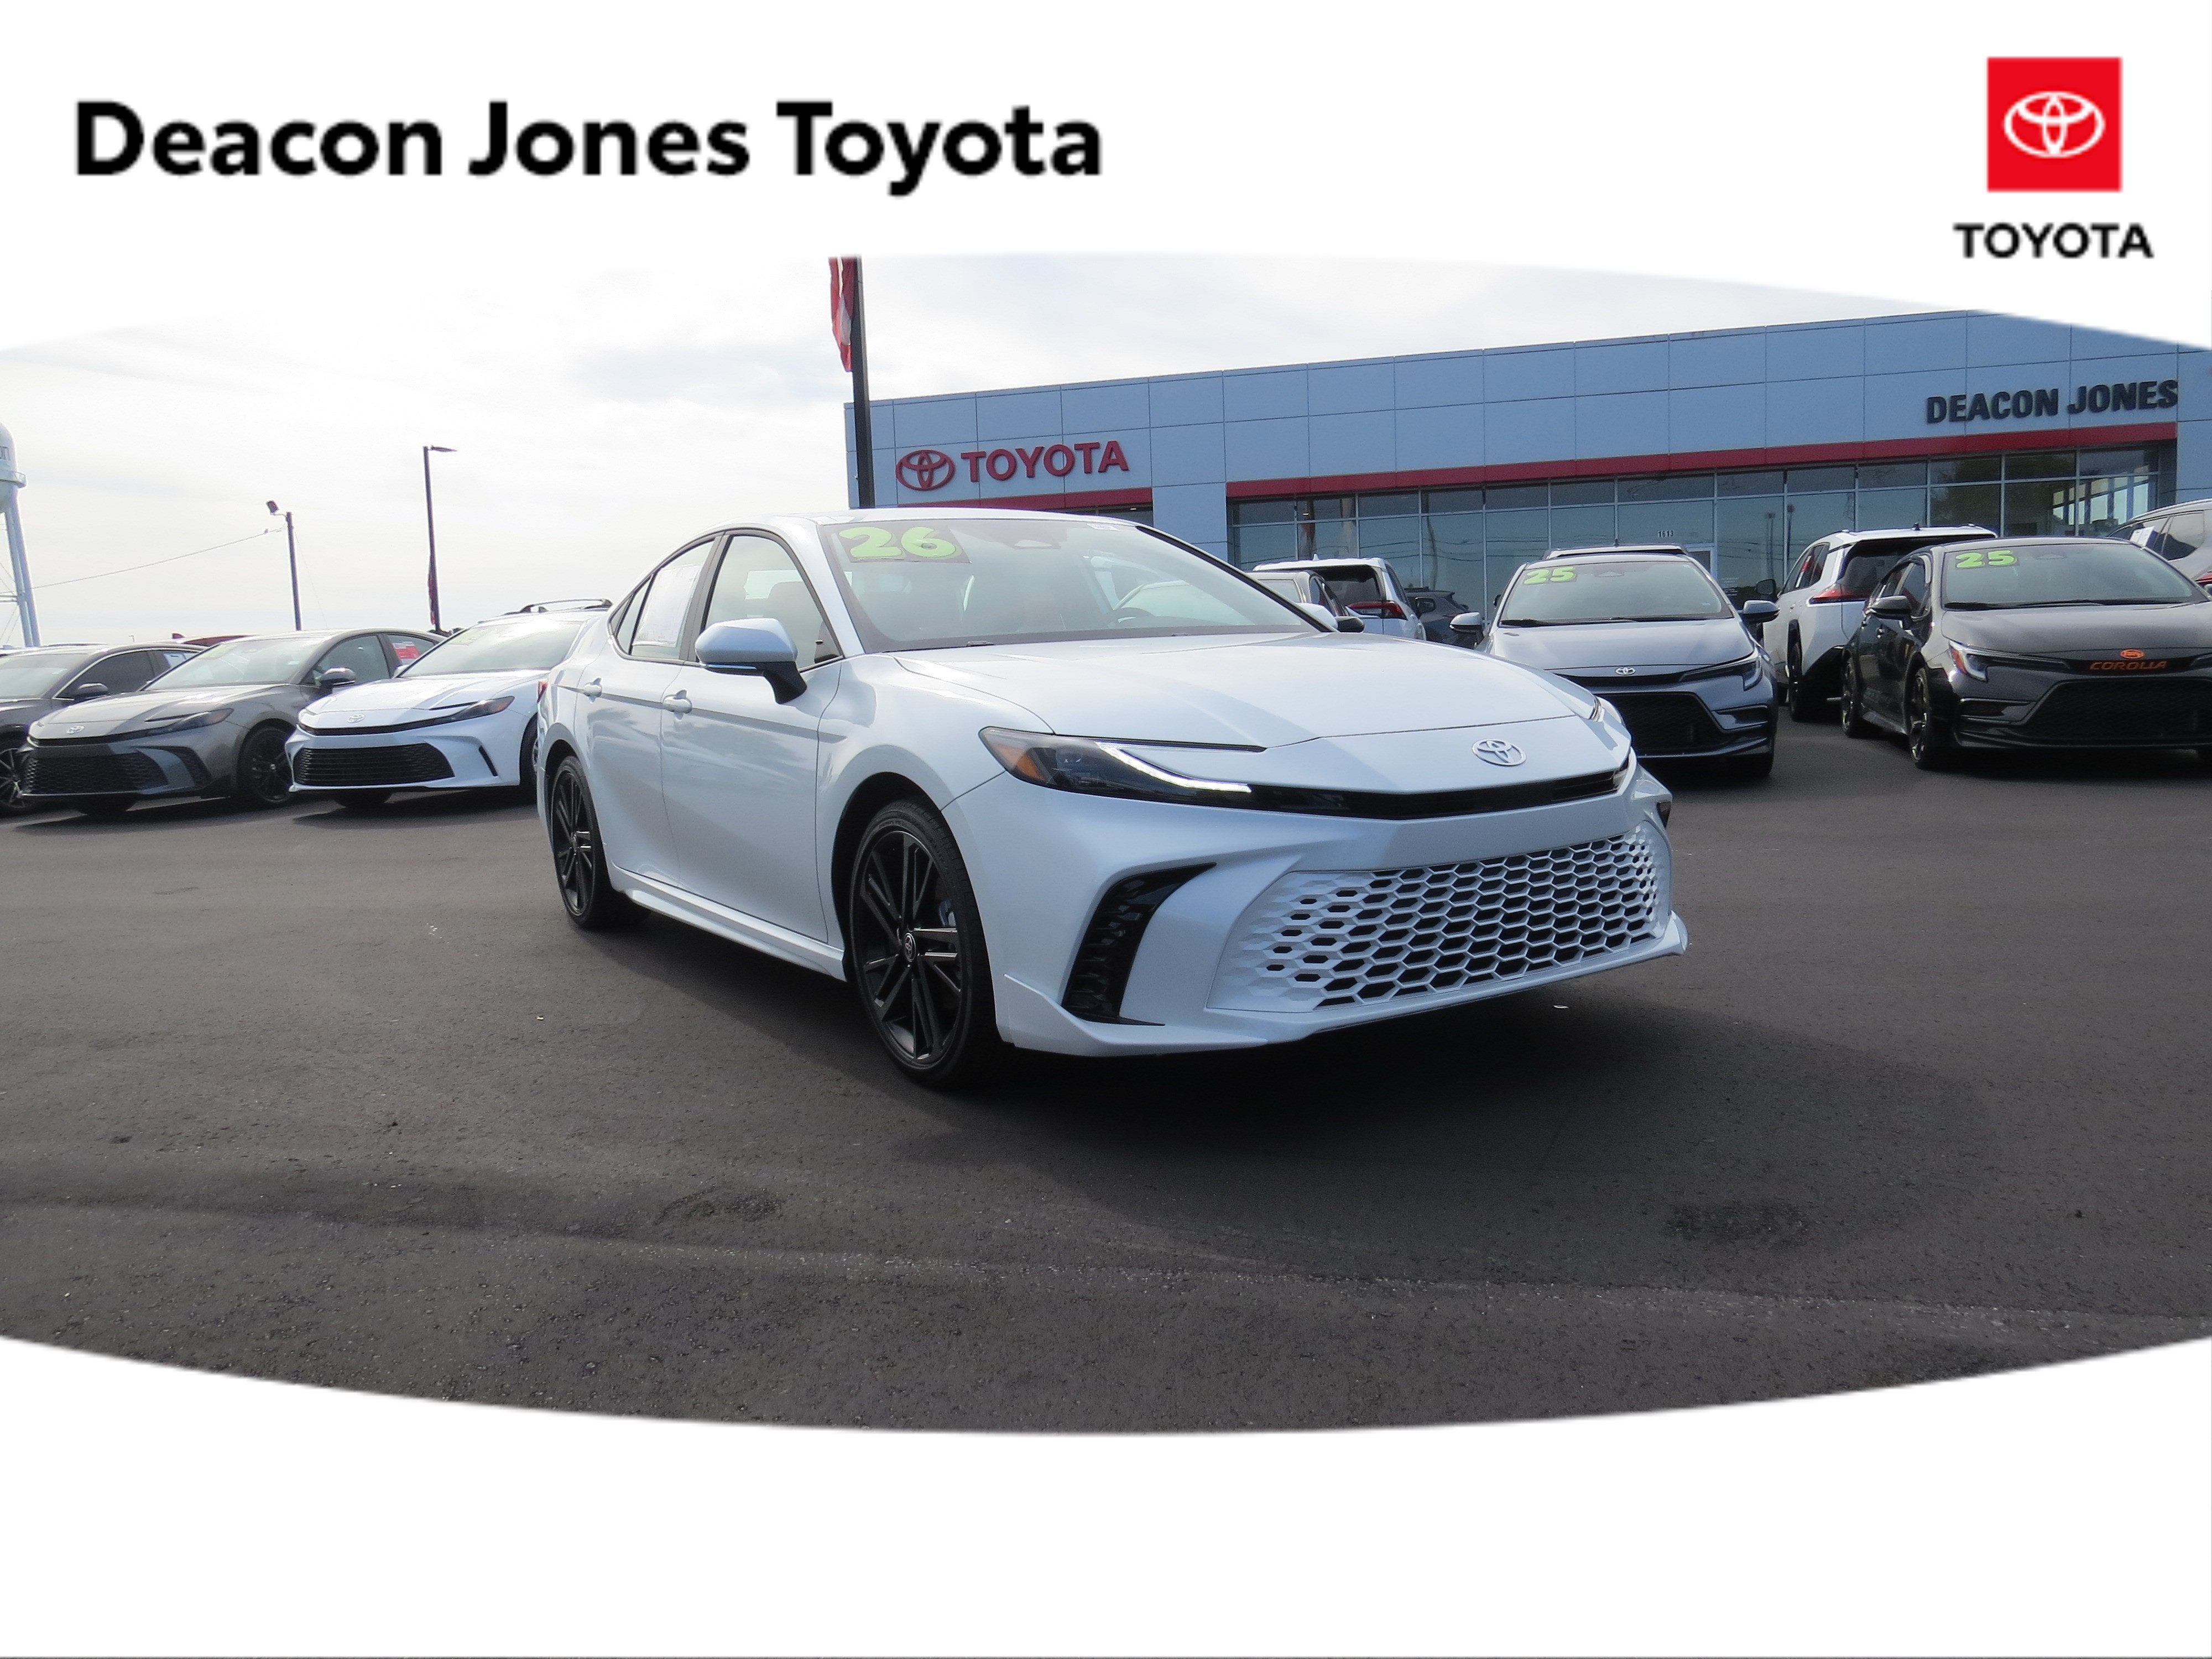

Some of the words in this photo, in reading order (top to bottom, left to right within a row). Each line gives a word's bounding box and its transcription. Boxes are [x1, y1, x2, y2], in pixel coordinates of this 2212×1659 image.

[1927, 389, 2058, 424] DEACON
[2068, 379, 2178, 414] JONES
[961, 441, 1128, 482] TOYOTA
[838, 526, 959, 559] 26
[1955, 550, 2017, 569] 25
[1523, 566, 1577, 585] 25
[2089, 661, 2167, 670] COROLLA
